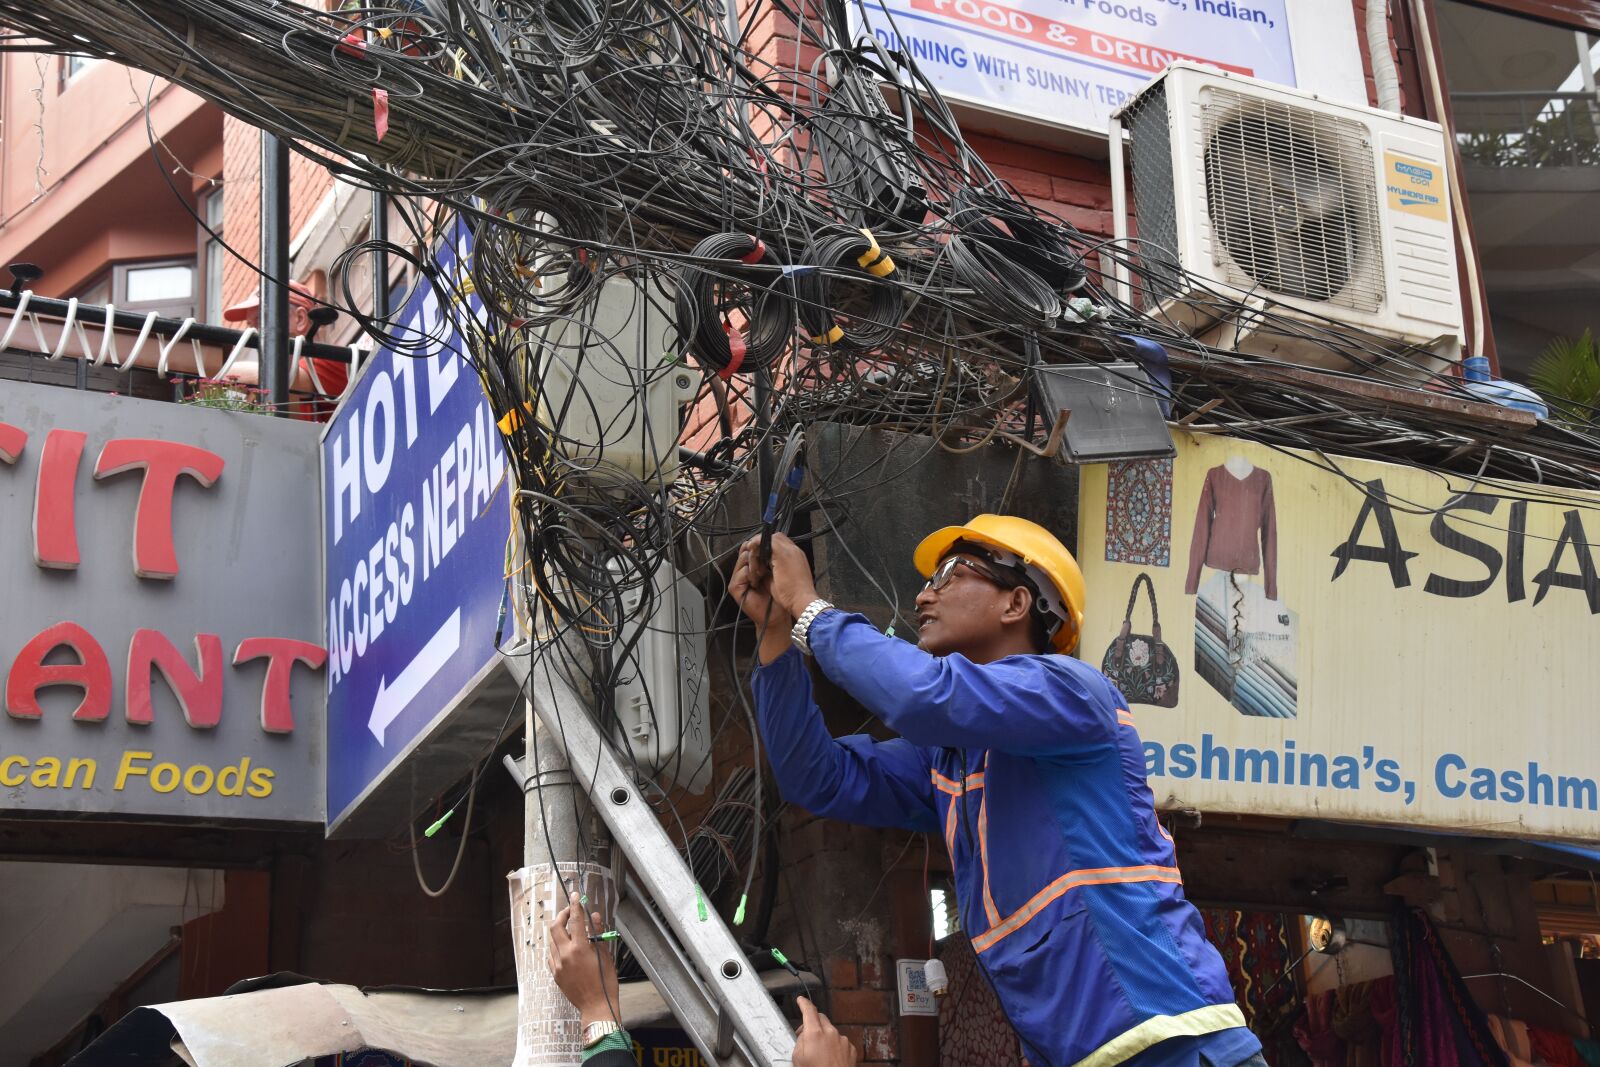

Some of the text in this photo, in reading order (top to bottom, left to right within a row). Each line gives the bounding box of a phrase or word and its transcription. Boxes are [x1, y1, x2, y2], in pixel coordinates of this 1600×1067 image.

[1195, 0, 1275, 28] Indian,
[973, 52, 1020, 82] WITH
[1026, 66, 1091, 99] SUNNY
[1045, 23, 1078, 46] &
[1090, 34, 1220, 70] DRIN
[334, 233, 488, 546] HOTEL
[0, 421, 226, 580] IT
[328, 393, 503, 694] ACCESS NEPAL
[6, 620, 328, 733] ANT
[0, 751, 275, 798] can Foods
[1434, 753, 1598, 811] Cashm
